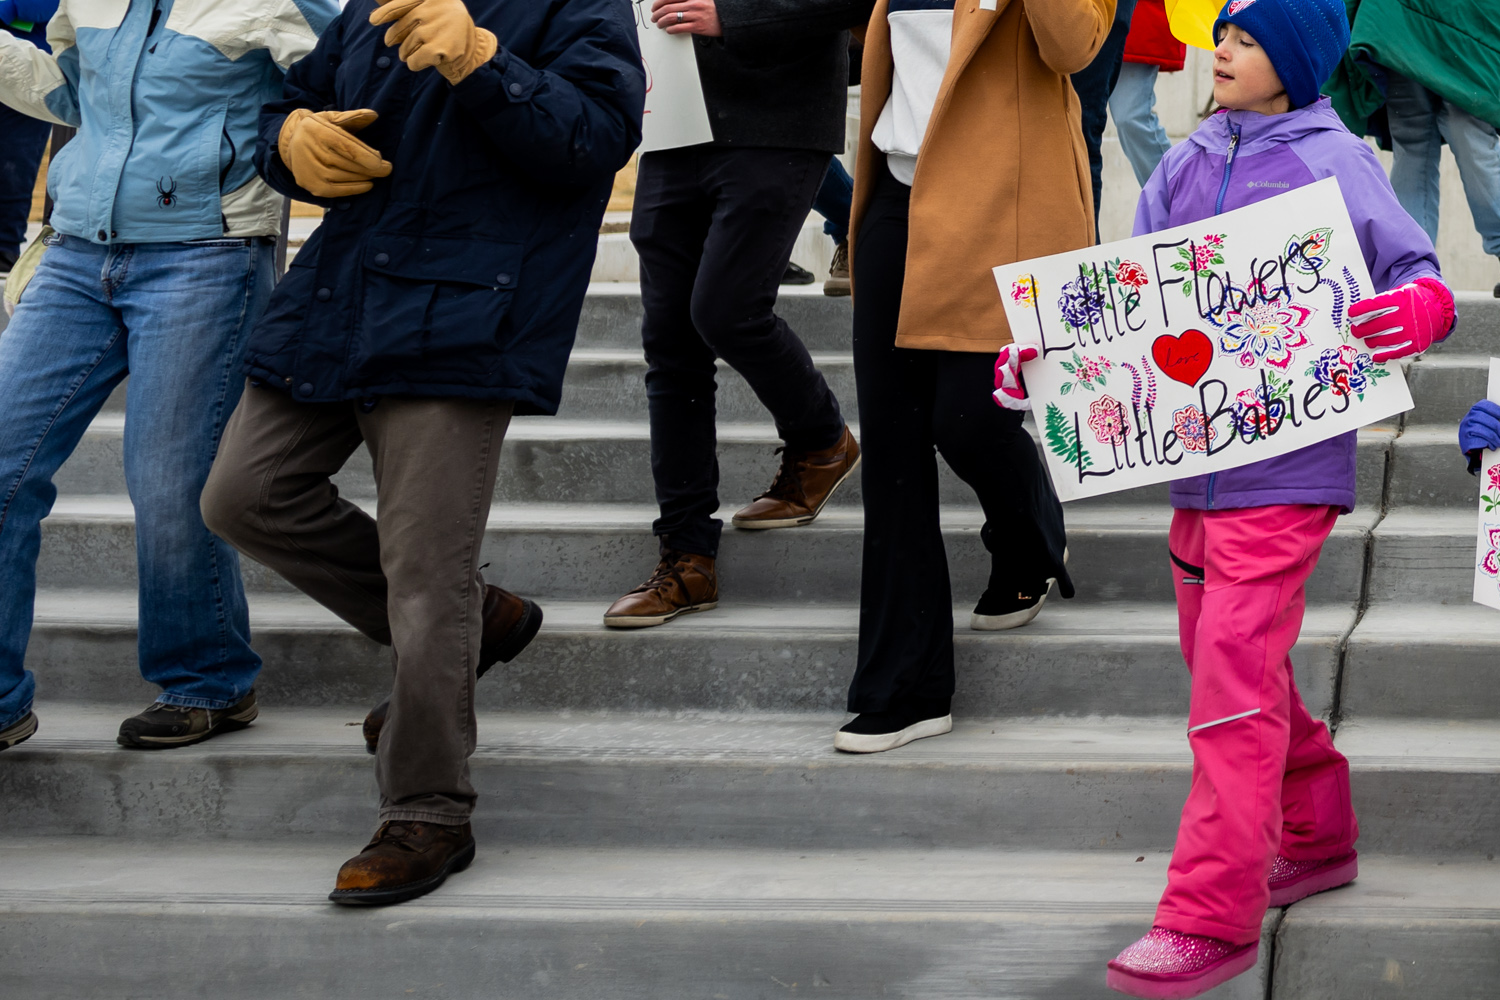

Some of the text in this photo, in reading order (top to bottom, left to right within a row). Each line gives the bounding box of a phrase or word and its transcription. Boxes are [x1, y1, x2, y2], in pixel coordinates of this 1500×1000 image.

[1031, 238, 1321, 359] Little Flowers
[1164, 346, 1200, 368] love
[1074, 368, 1350, 483] Little Babies
